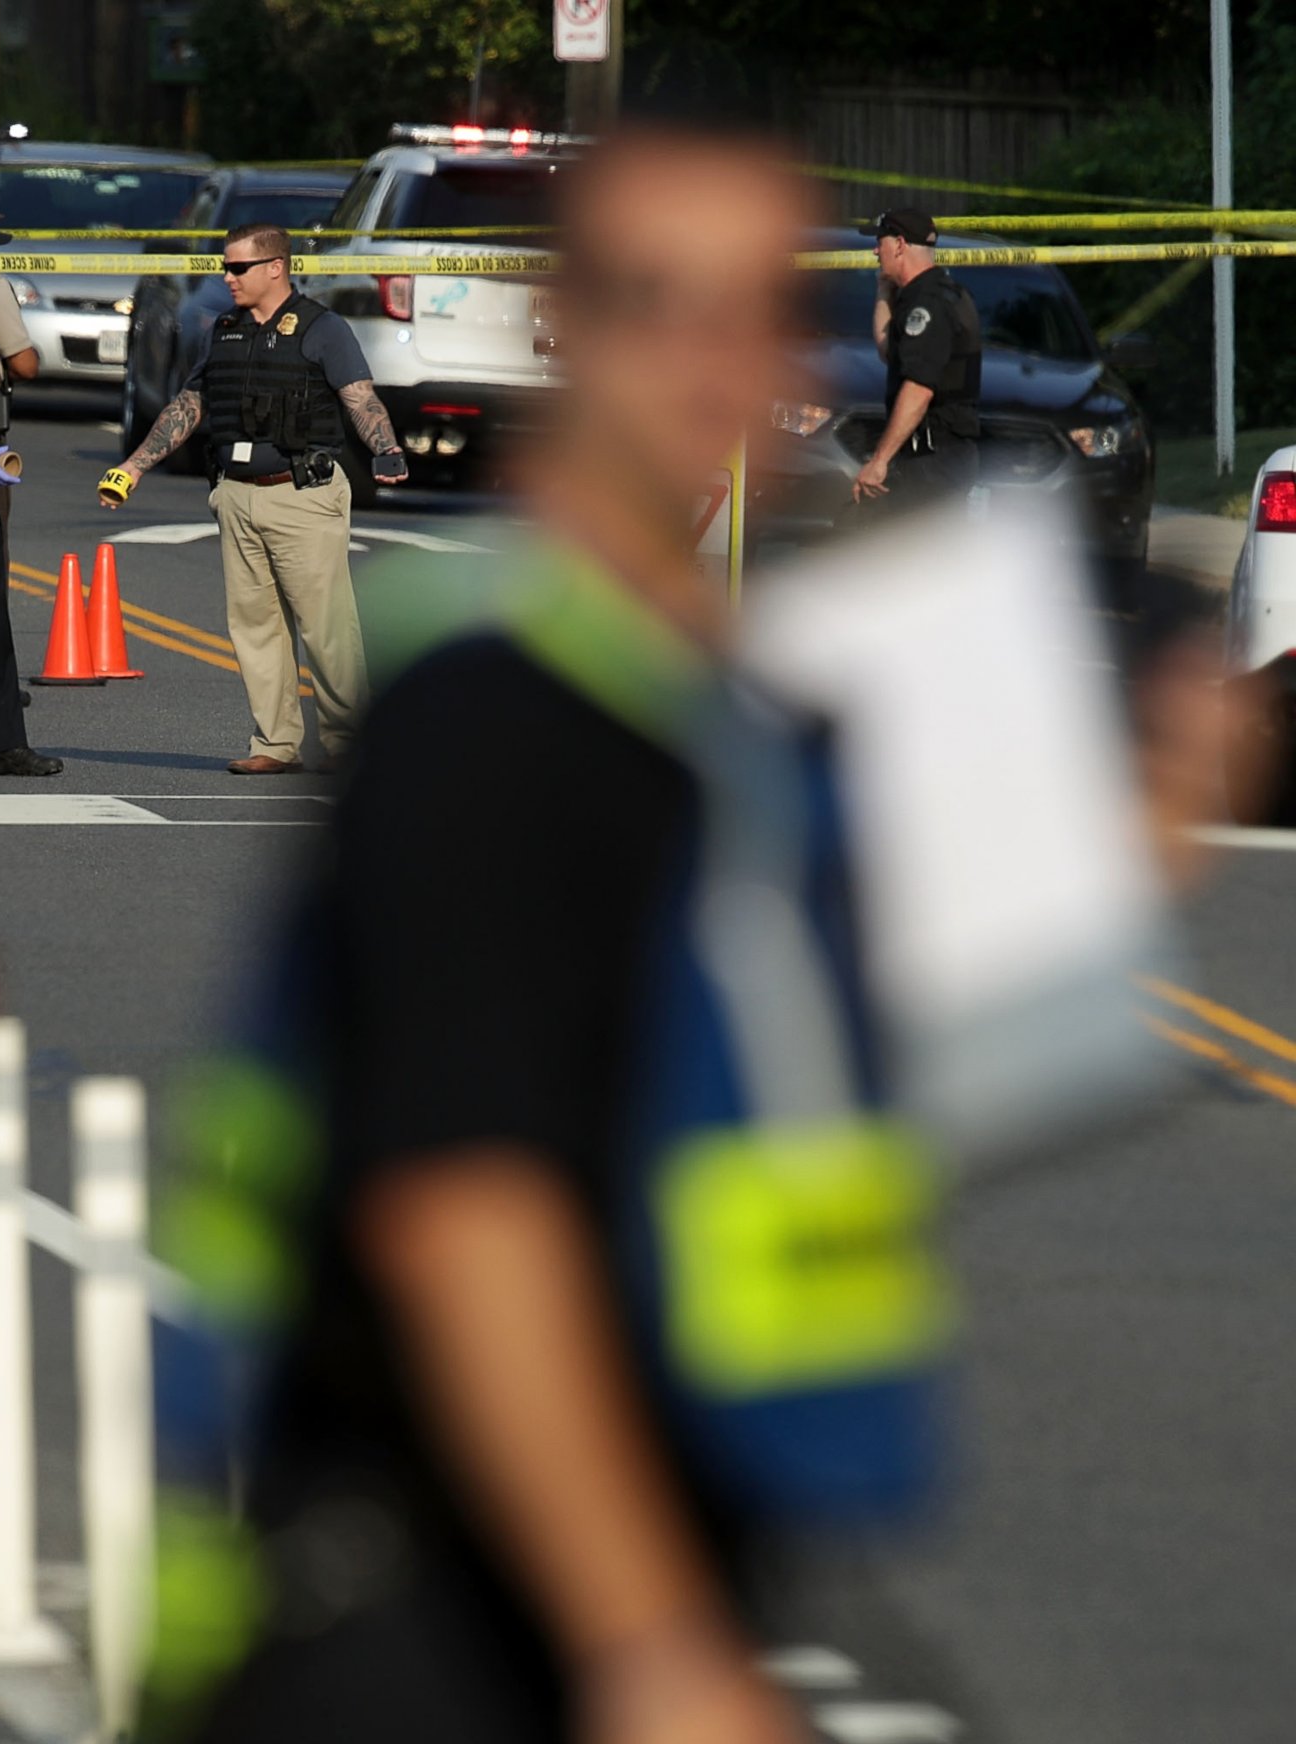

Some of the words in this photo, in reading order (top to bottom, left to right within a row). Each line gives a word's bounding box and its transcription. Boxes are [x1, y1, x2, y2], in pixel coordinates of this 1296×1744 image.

[0, 256, 27, 270] SCENE
[28, 257, 56, 270] CRIME
[189, 257, 217, 270] CROSS
[436, 257, 463, 271] CROSS
[465, 257, 480, 271] NOT
[482, 257, 494, 271] DO
[495, 257, 520, 271] SCENE
